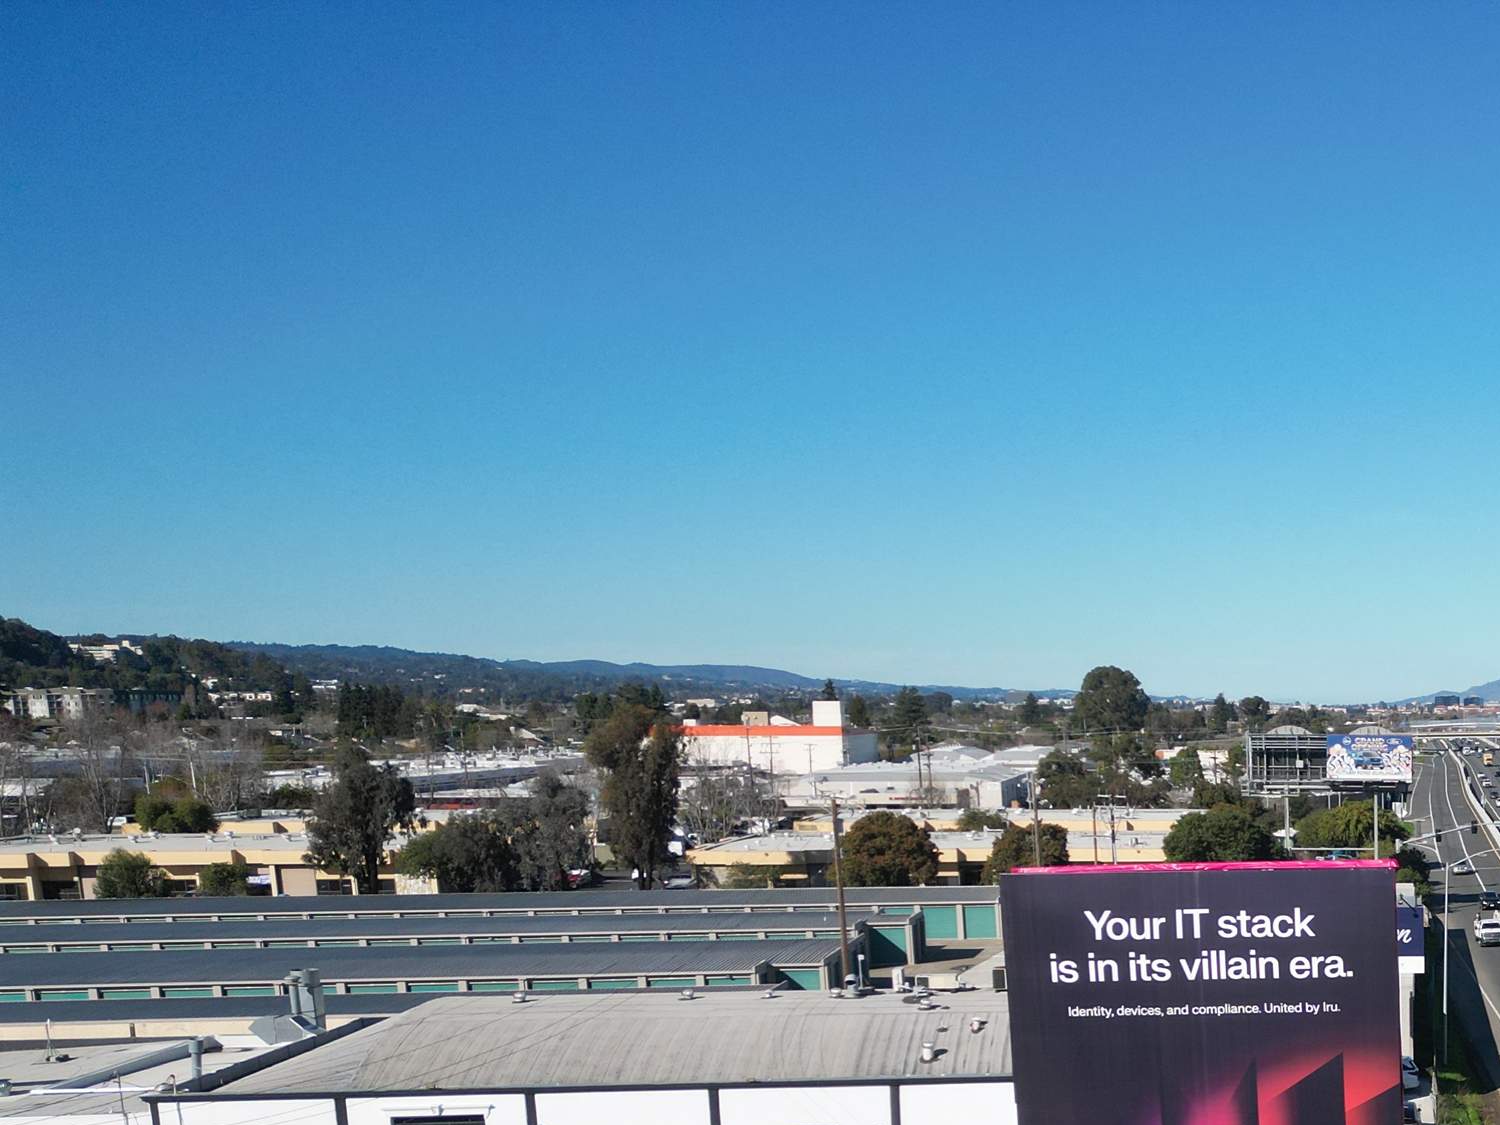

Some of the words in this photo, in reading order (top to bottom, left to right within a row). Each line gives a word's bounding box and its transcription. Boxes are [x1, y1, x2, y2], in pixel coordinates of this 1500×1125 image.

[1084, 909, 1166, 940] Your
[1176, 909, 1209, 939] IT
[1218, 907, 1315, 938] stack
[1050, 953, 1079, 983] is
[1088, 953, 1119, 983] in
[1129, 952, 1171, 982] its
[1180, 949, 1279, 980] villain
[1289, 956, 1353, 979] era.
[1068, 1006, 1114, 1018] Identity,
[1117, 1005, 1164, 1016] devices,
[1166, 1004, 1189, 1015] and
[1192, 1003, 1262, 1016] compliance.
[1264, 1002, 1302, 1013] United
[1306, 1002, 1320, 1015] by
[1323, 1001, 1341, 1012] Iru.
